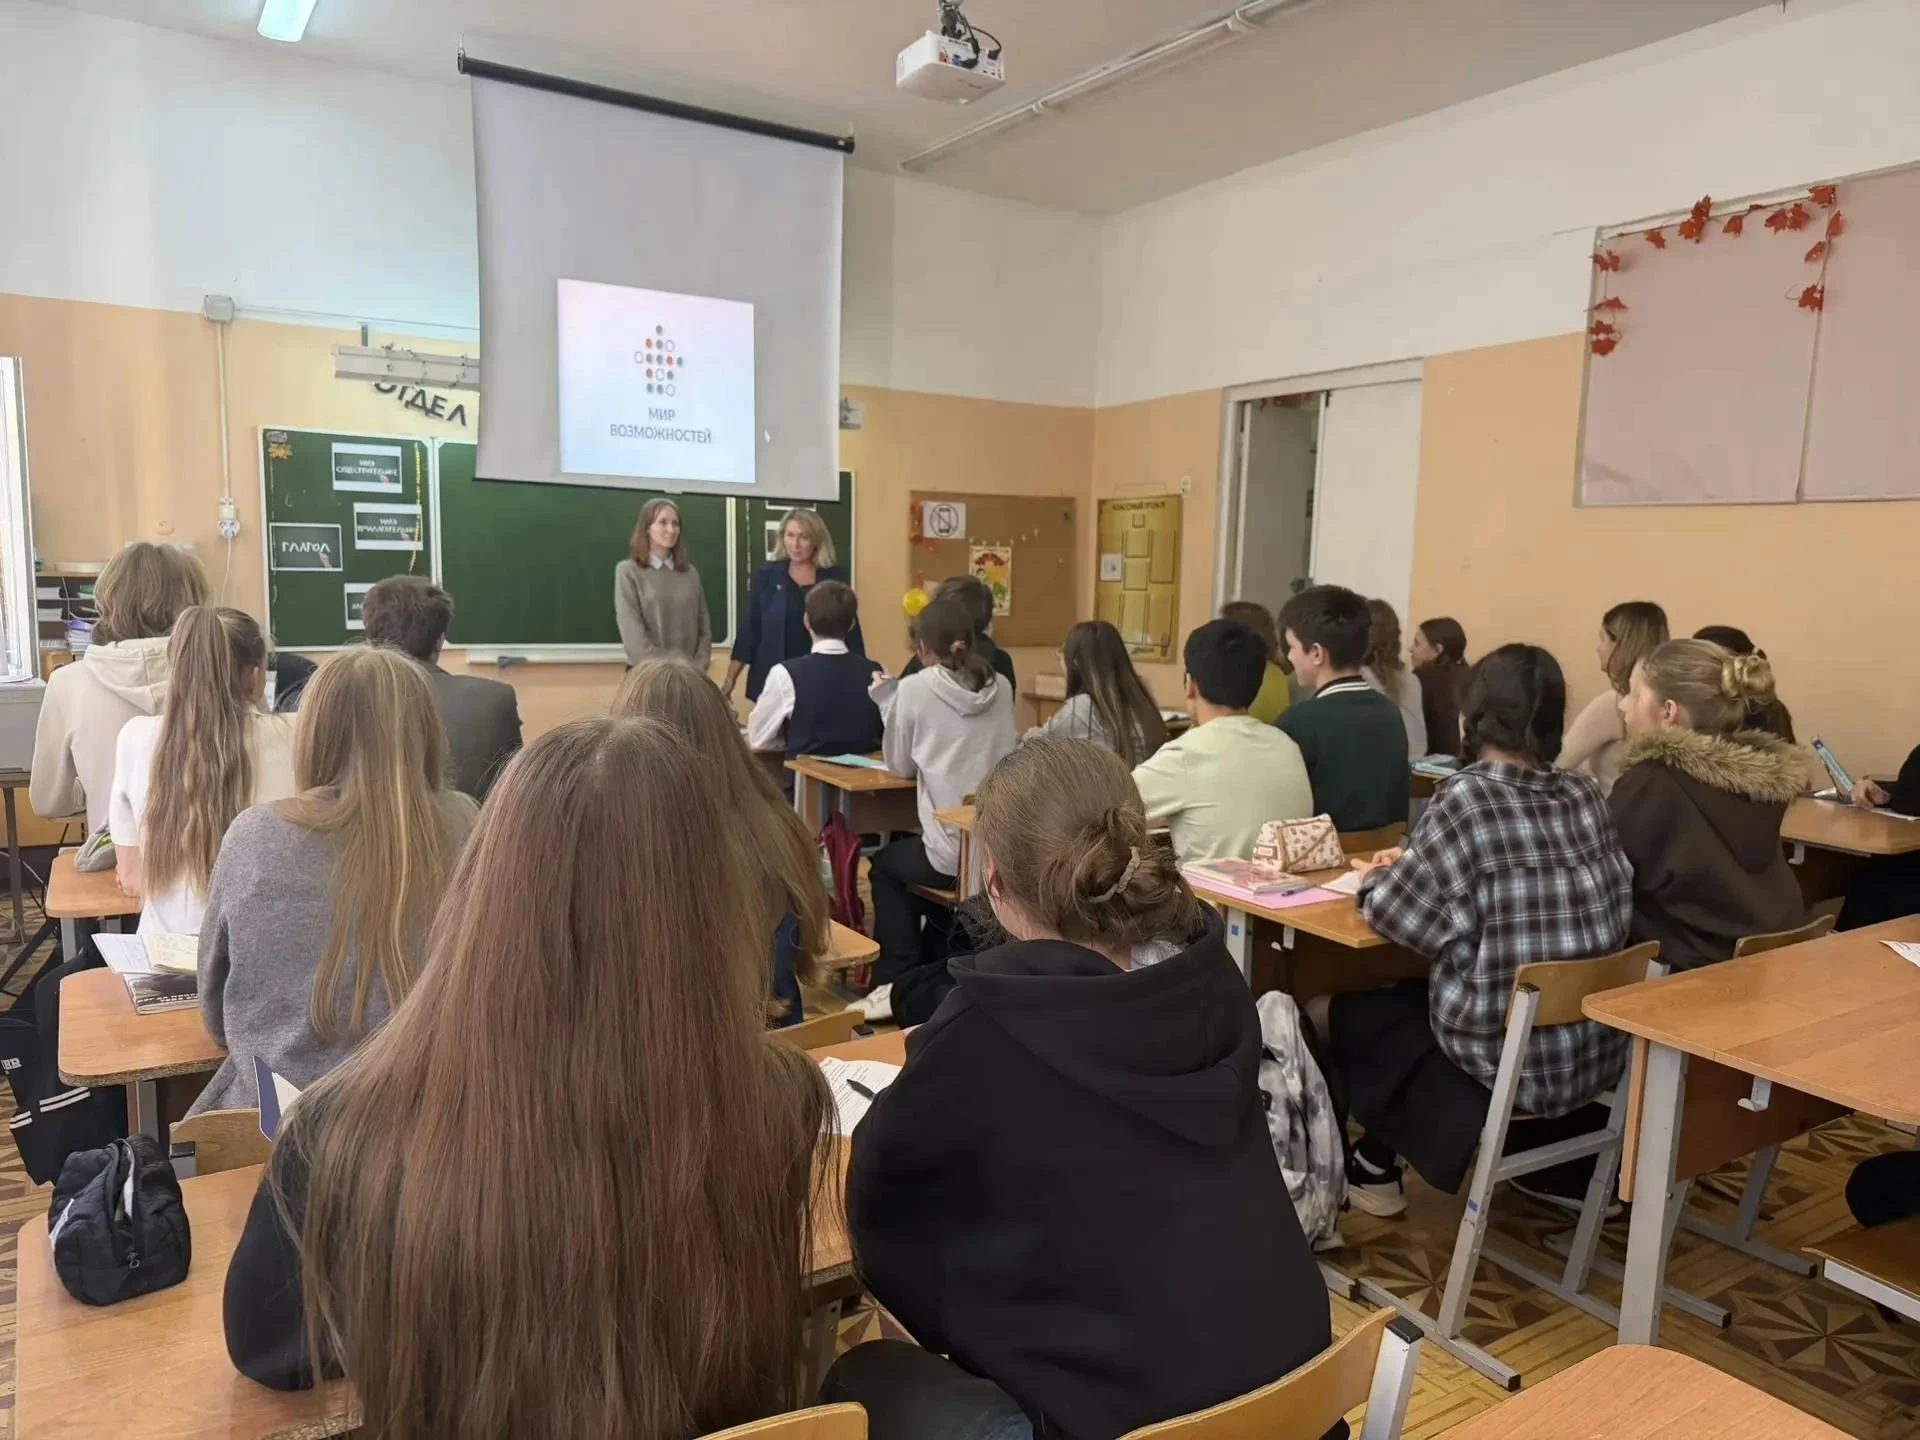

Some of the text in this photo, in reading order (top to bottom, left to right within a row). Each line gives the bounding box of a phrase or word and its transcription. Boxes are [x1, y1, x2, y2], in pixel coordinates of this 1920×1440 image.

[648, 407, 676, 421] МИР
[609, 423, 712, 444] ВОЗМОЖНОСТЕЙ
[282, 541, 331, 553] ГЛАГОЛ
